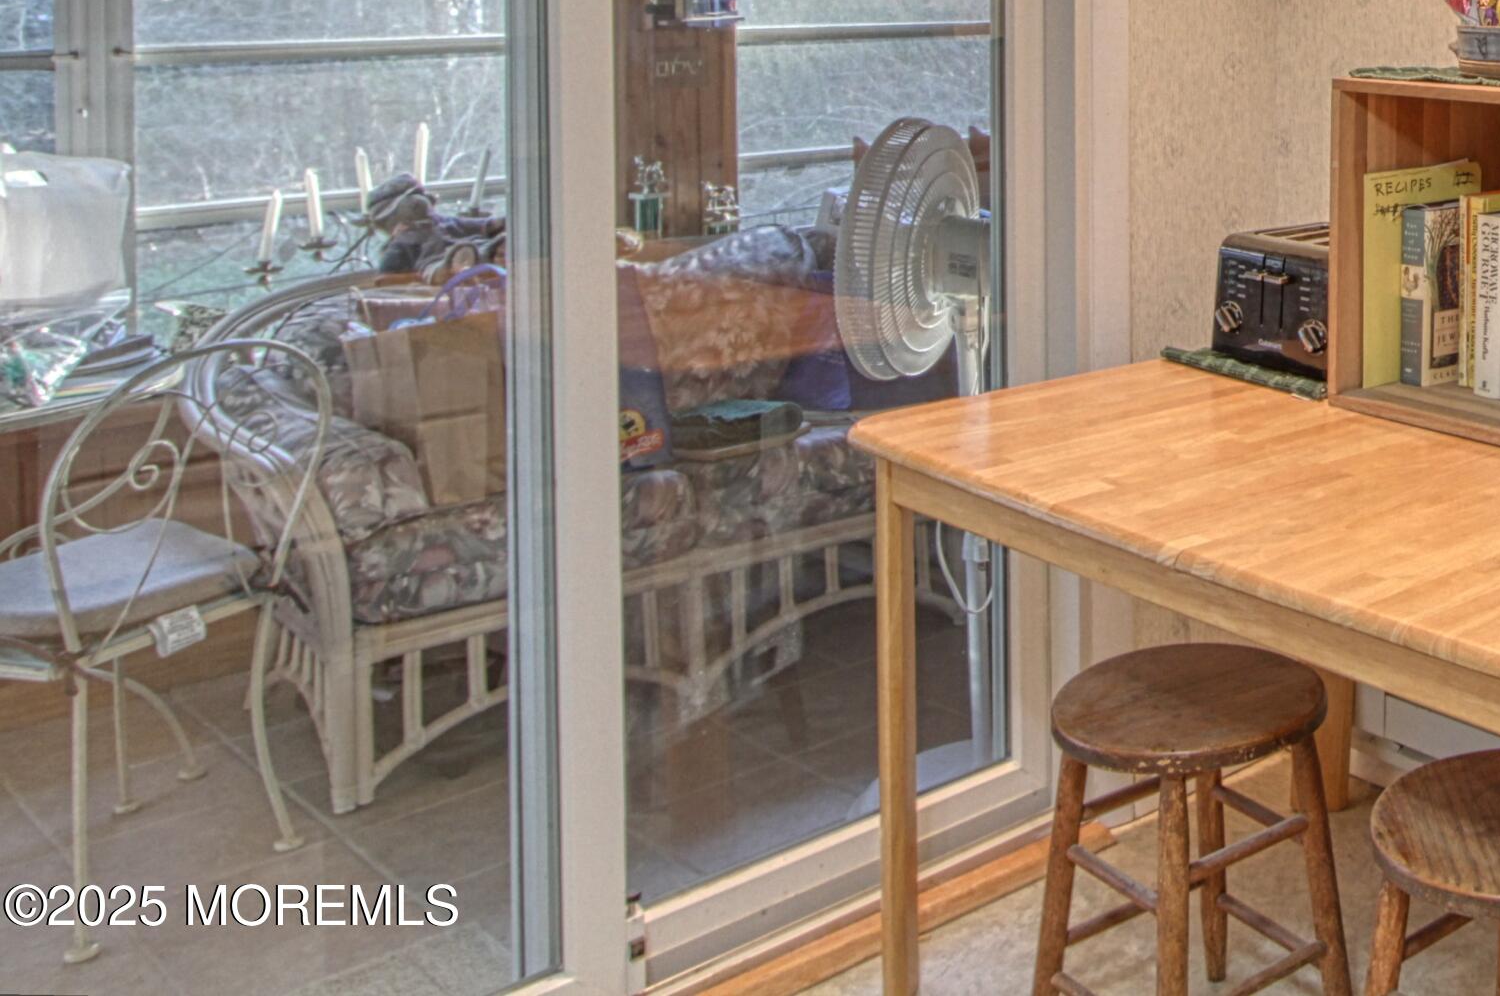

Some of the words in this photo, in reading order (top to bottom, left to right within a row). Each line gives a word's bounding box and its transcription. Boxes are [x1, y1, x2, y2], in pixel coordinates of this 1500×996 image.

[1374, 177, 1432, 197] RECIPES
[1479, 222, 1490, 301] GOURMET
[1488, 224, 1499, 305] MICROWAVE
